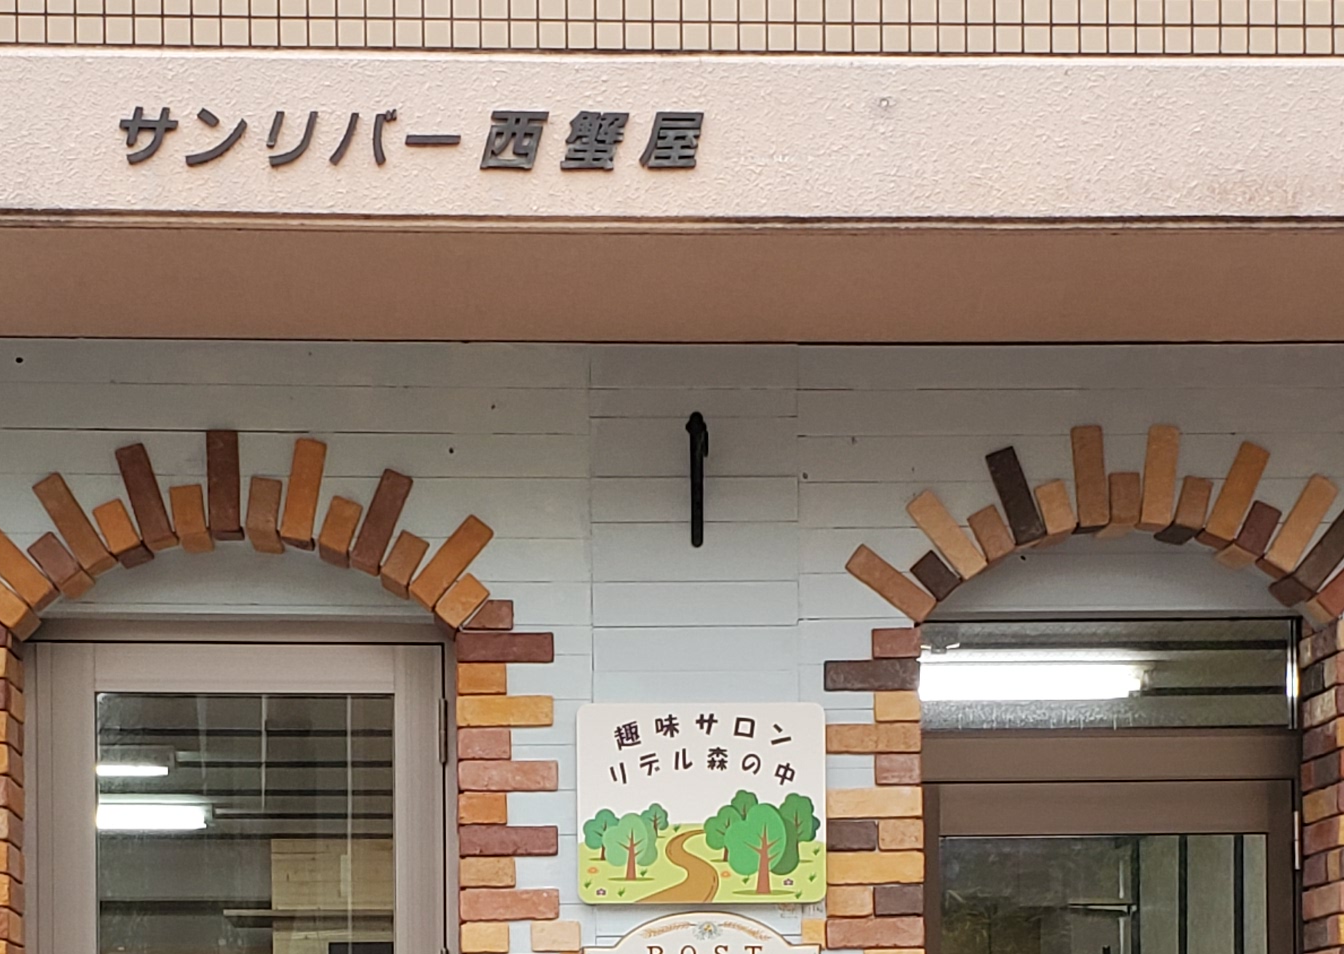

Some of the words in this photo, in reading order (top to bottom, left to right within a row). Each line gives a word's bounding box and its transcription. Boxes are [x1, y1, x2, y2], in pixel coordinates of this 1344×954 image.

[118, 106, 704, 171] サンリバー西蟹屋
[613, 713, 792, 751] 趣味サロン
[609, 747, 796, 786] リデル森の中
